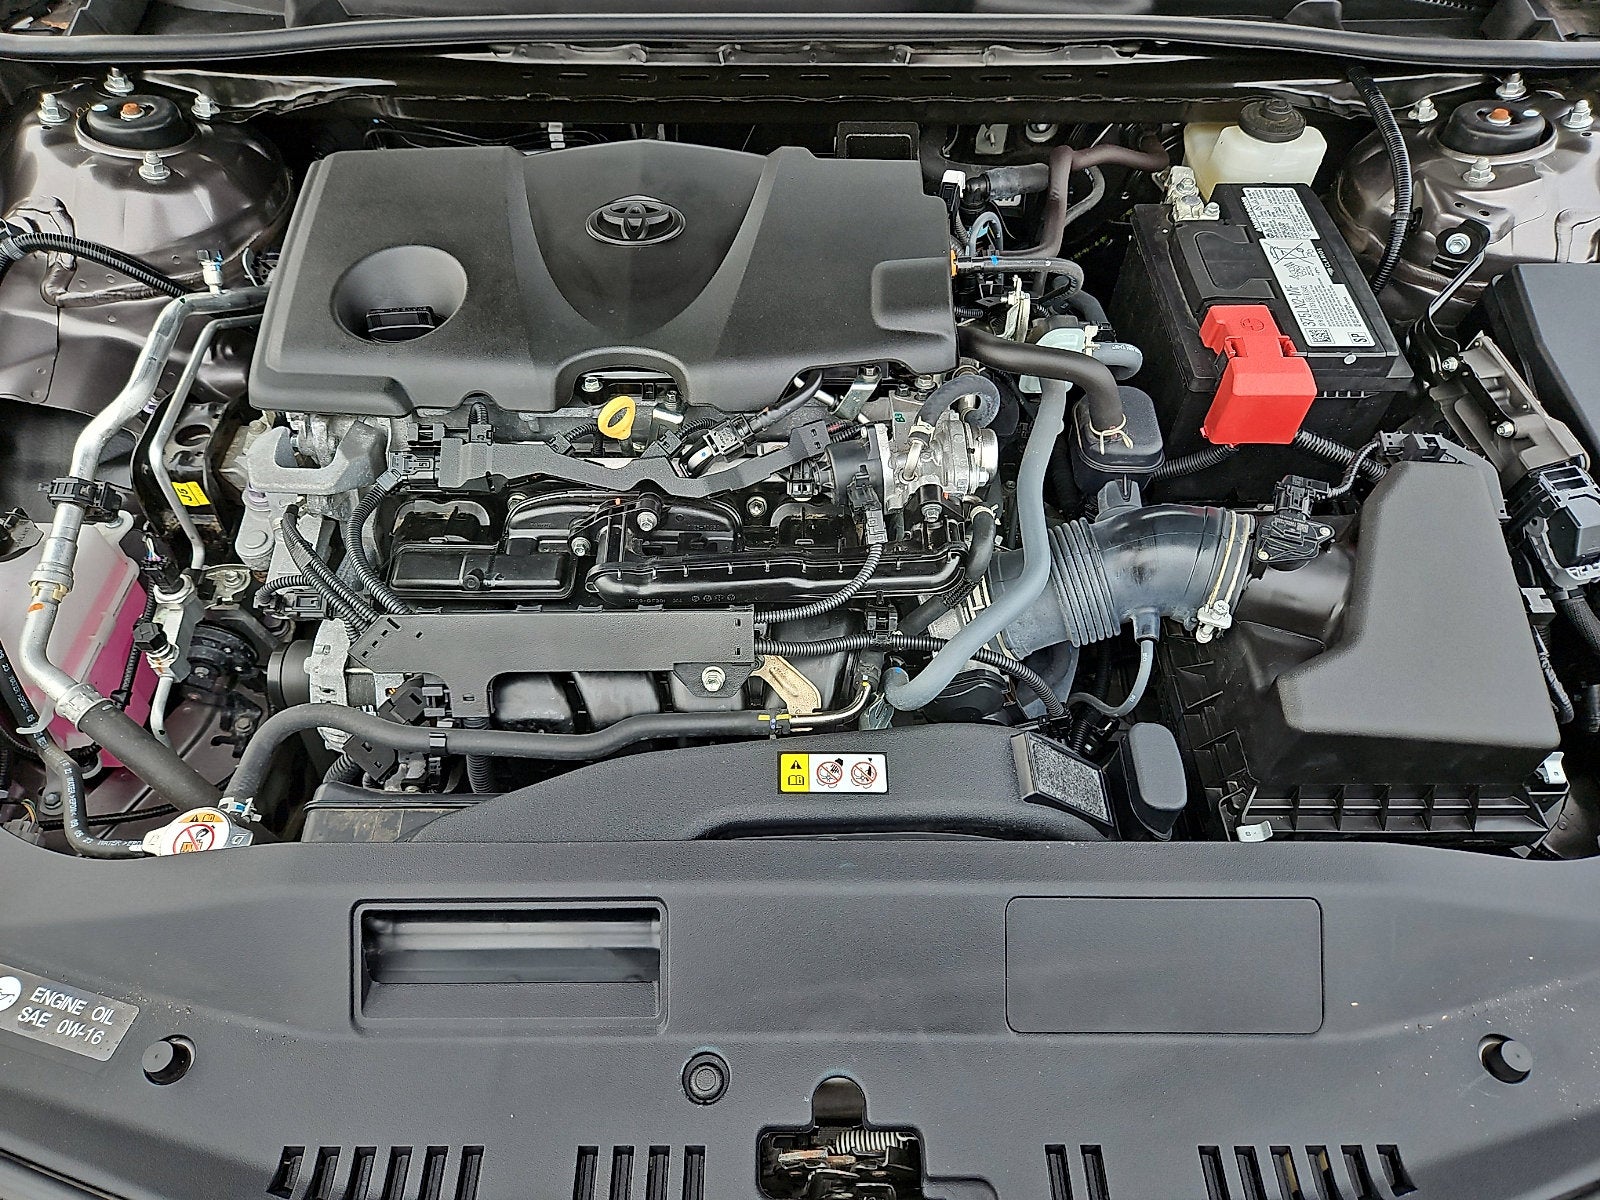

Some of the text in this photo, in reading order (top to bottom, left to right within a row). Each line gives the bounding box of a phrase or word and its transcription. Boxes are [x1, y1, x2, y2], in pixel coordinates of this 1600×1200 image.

[1350, 333, 1368, 343] SP
[18, 1005, 105, 1045] SAE 0W-16
[30, 986, 115, 1026] ENGINE OIL
